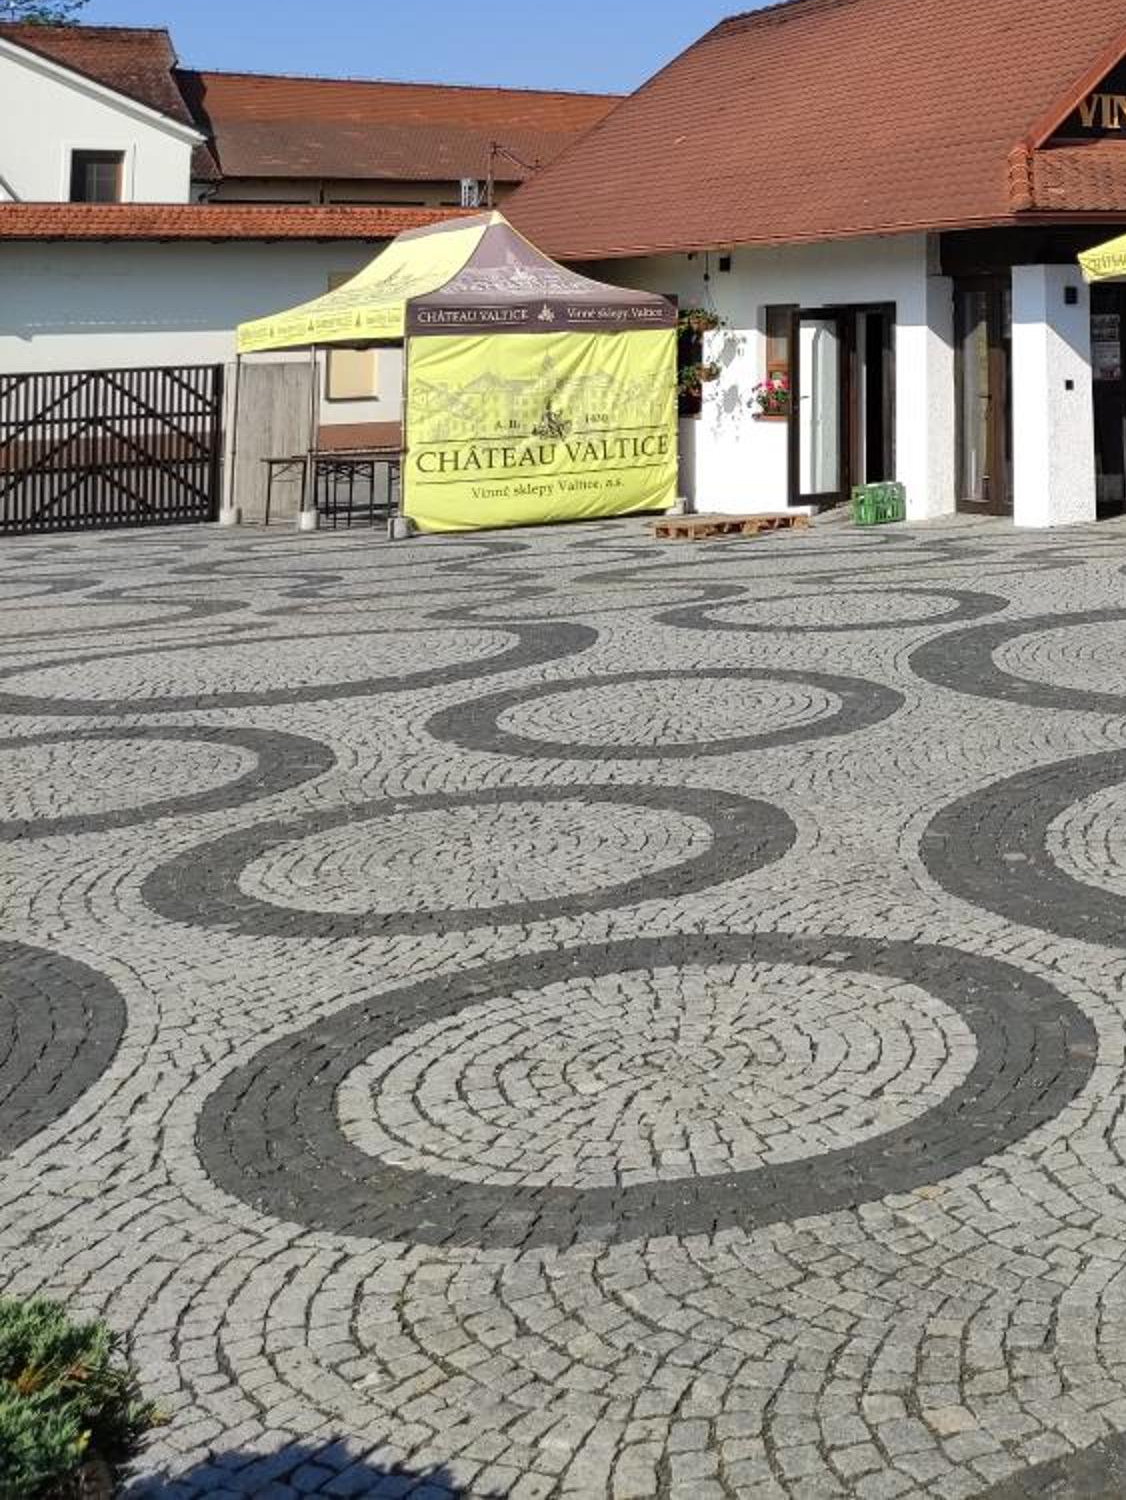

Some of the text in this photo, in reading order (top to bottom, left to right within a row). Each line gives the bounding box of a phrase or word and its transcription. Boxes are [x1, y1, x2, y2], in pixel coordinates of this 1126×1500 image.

[417, 309, 477, 323] CHÂTEAU
[479, 309, 529, 321] VALTICE
[416, 434, 670, 474] CHÂTEAU VALTICE
[471, 485, 510, 500] Vinné
[512, 481, 554, 499] sklepy
